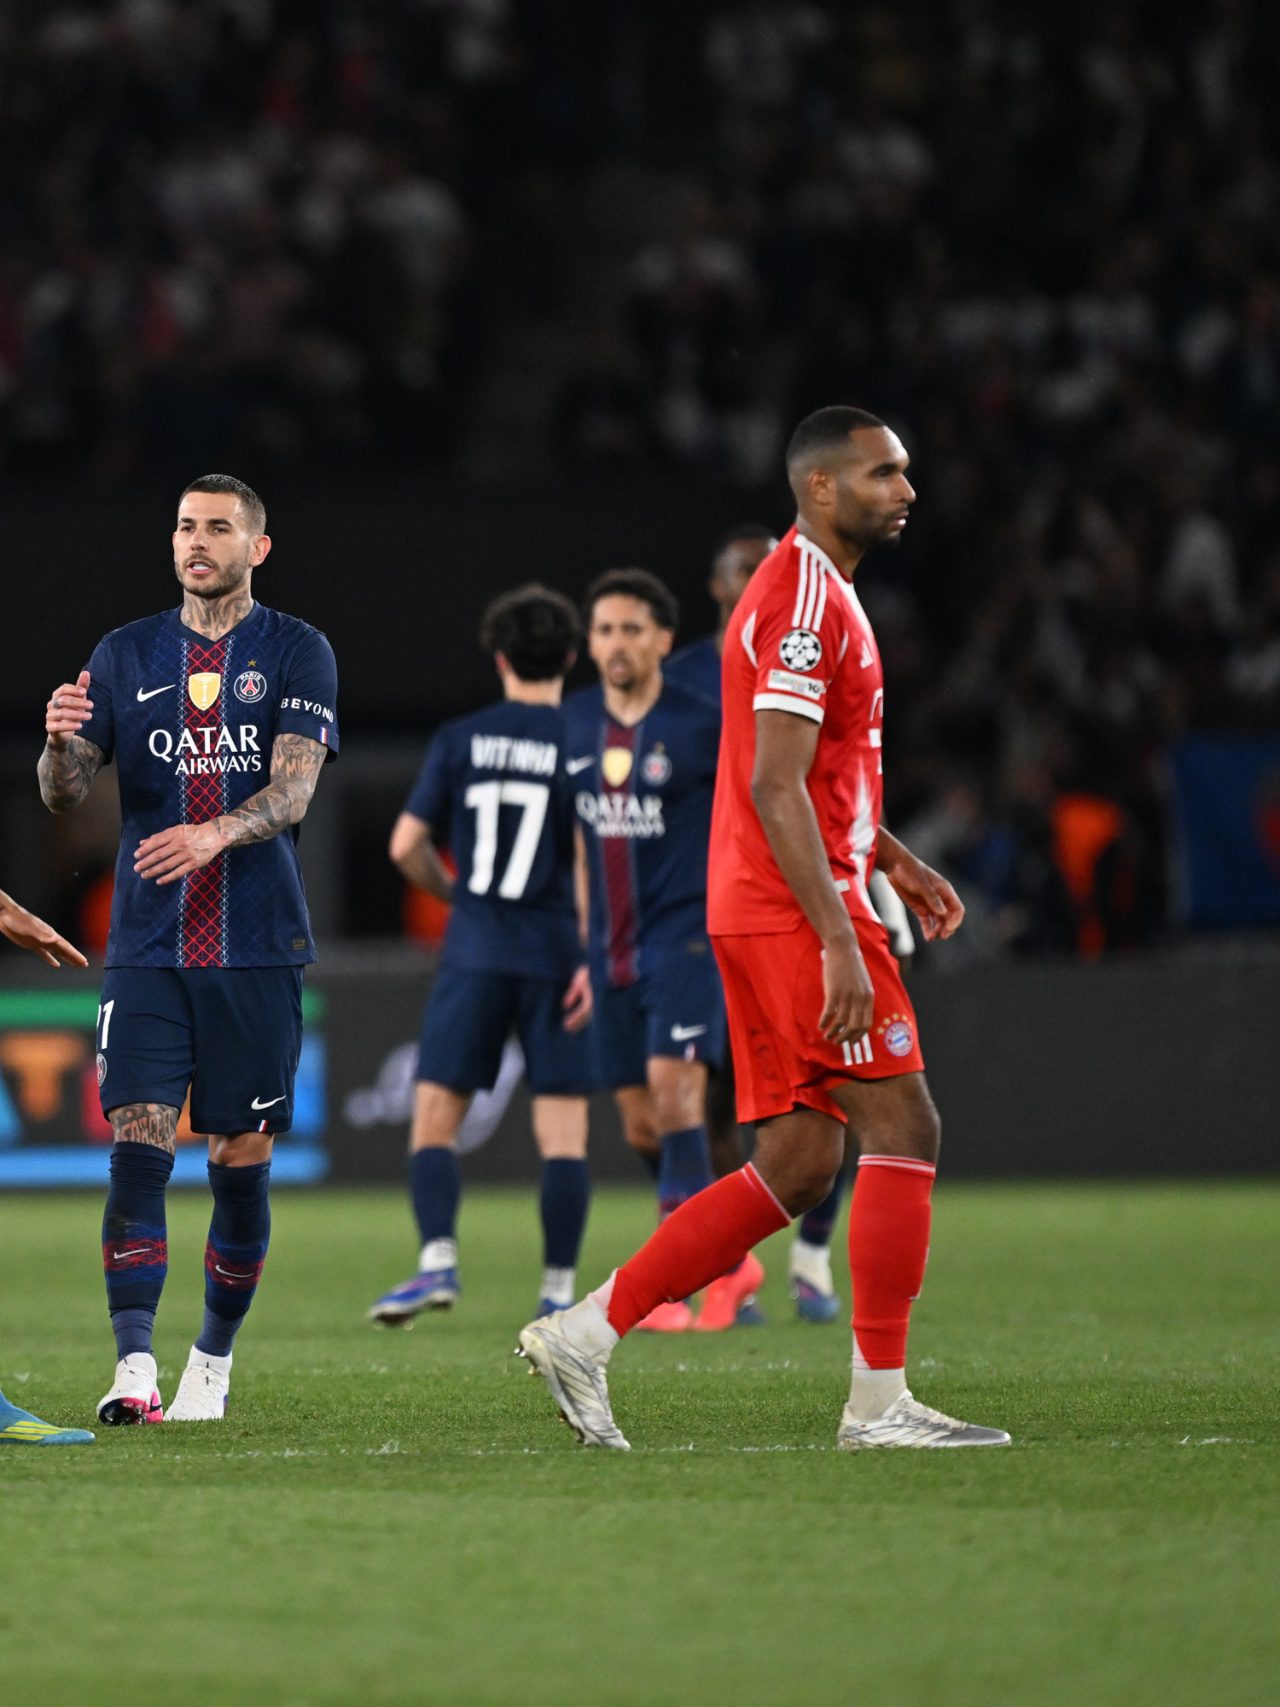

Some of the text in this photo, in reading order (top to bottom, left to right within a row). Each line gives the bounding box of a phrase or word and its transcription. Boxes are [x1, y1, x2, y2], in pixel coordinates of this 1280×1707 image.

[281, 697, 334, 723] BEYOND
[149, 724, 261, 763] QATAR
[175, 755, 261, 775] AIRWAYS
[575, 790, 664, 827] QATAR
[464, 779, 550, 900] 17
